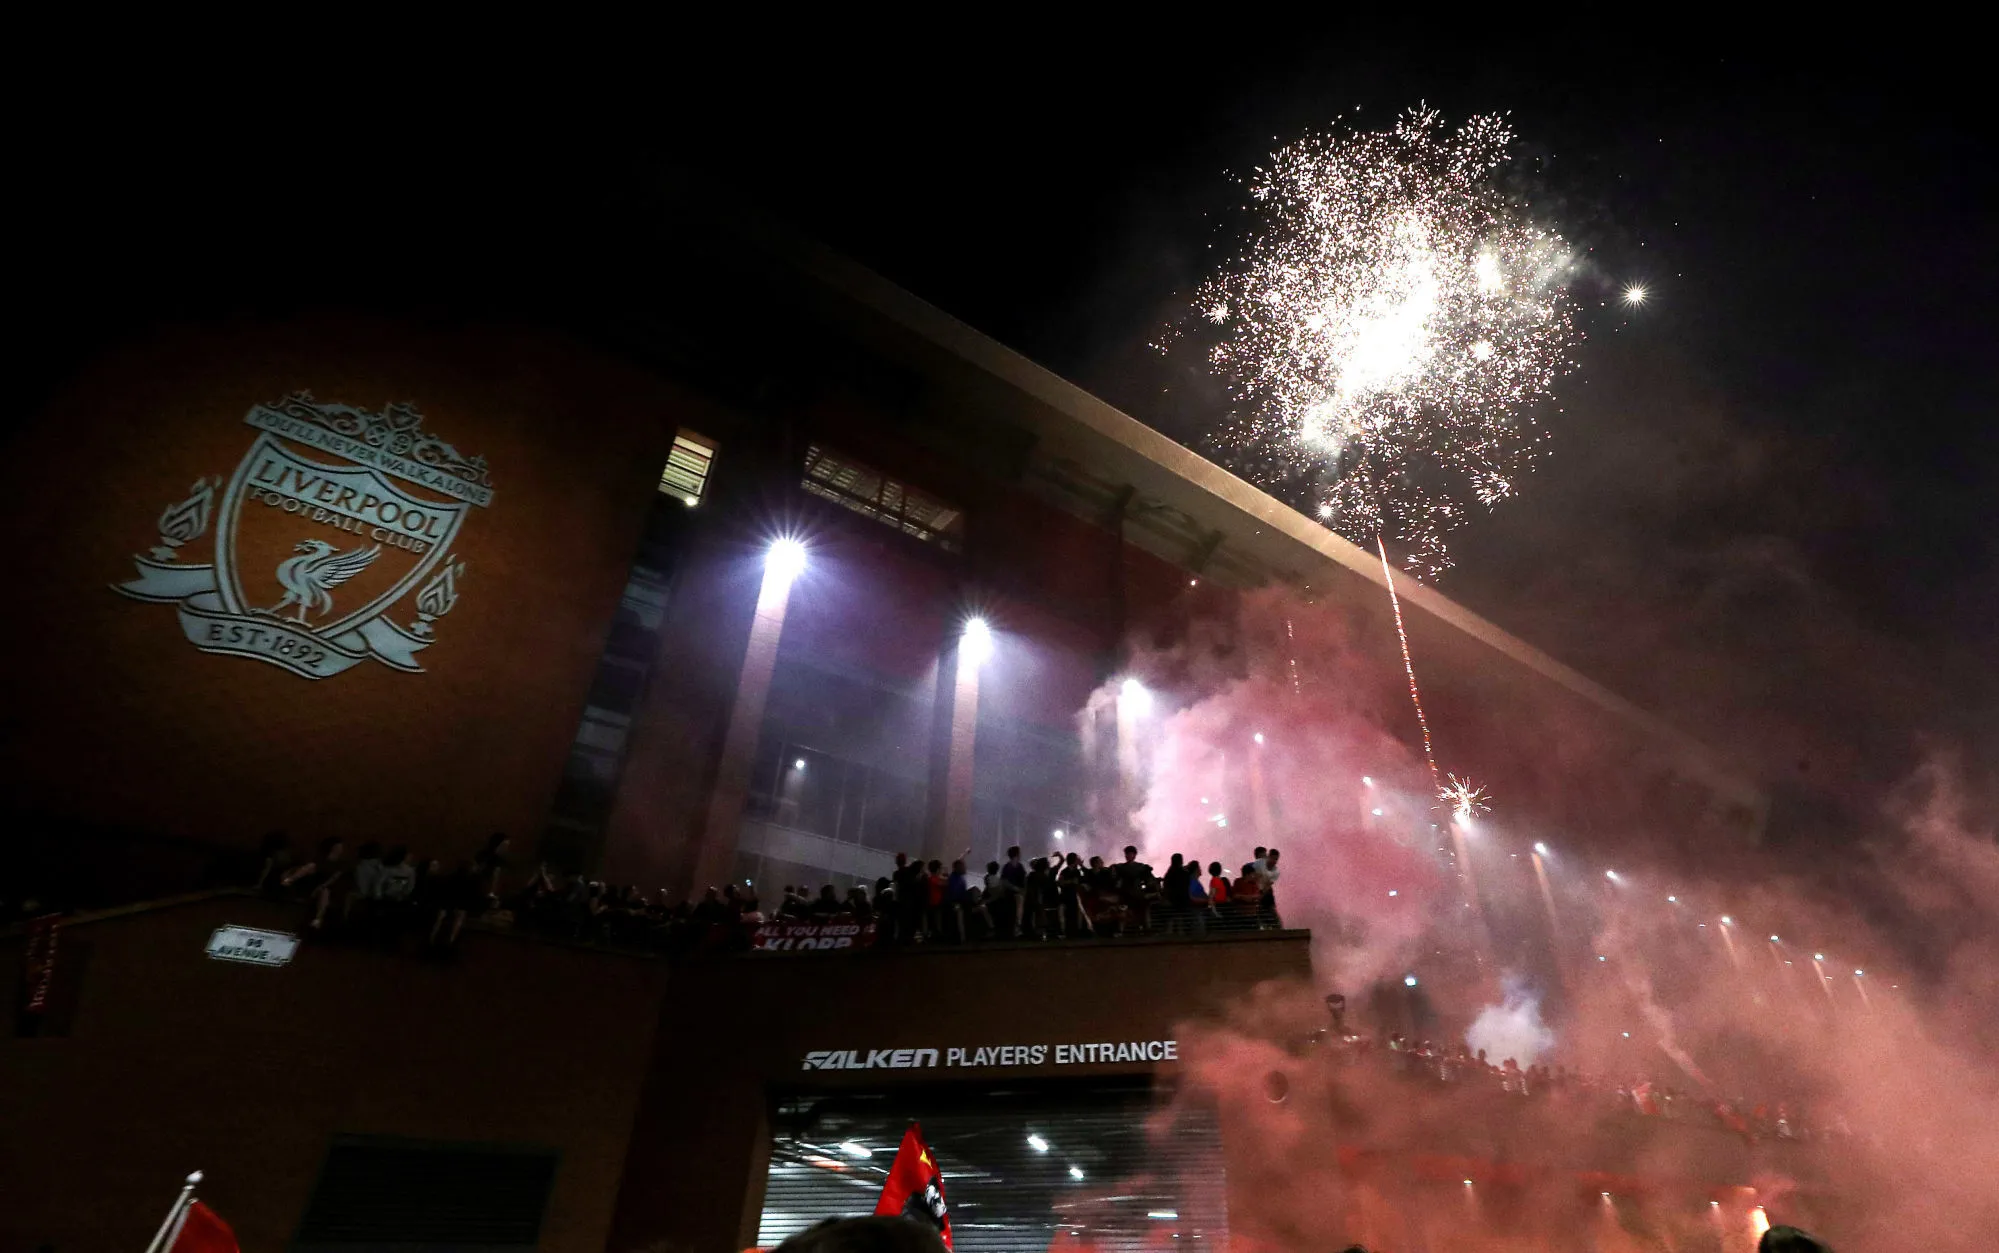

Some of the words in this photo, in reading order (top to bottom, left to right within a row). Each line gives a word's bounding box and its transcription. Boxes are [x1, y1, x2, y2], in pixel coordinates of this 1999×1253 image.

[255, 410, 314, 440] YOU'LL
[314, 434, 376, 461] NEVER
[379, 456, 430, 484] WALK
[429, 475, 489, 503] ALONE
[251, 487, 363, 535] FOOTBALL
[370, 528, 426, 555] CLUB
[255, 459, 441, 538] LIVERPOOL
[218, 946, 269, 960] AVENUE
[755, 926, 780, 937] ALL
[785, 925, 819, 937] YOU
[820, 924, 860, 937] NEED
[802, 1049, 939, 1070] FALKEN
[947, 1045, 1048, 1067] PLAYERS'
[1055, 1041, 1178, 1064] ENTRANCE
